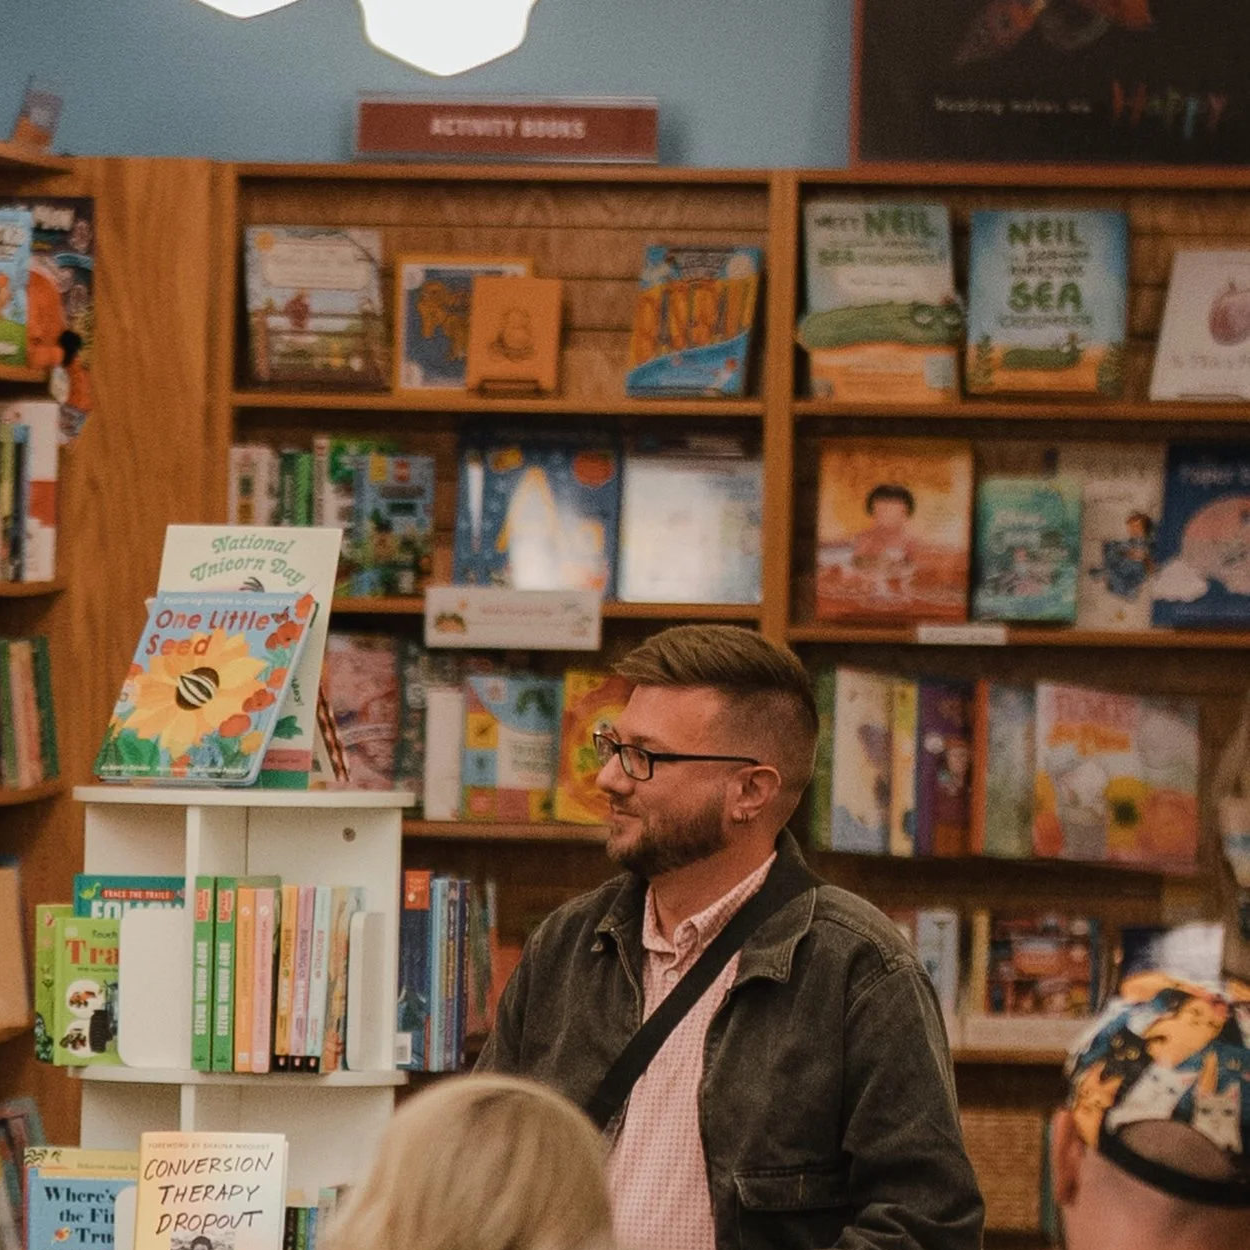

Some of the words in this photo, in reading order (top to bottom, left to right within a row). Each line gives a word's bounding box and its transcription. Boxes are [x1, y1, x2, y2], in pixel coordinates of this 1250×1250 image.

[431, 116, 515, 137] ACTIVITY
[520, 119, 586, 140] BOOKS
[1007, 218, 1084, 247] NEIL
[1007, 282, 1084, 313] SEA
[211, 533, 296, 555] National
[189, 555, 265, 582] Unicorn
[270, 555, 306, 588] Day
[155, 609, 202, 630] One
[208, 607, 271, 631] Little
[146, 634, 213, 657] Seed
[103, 889, 127, 898] TRACE
[129, 890, 143, 899] THE
[145, 891, 171, 900] TRAILS
[143, 1152, 274, 1181] CONVERSION
[44, 1186, 116, 1203] Where's
[158, 1183, 260, 1206] THERAPY
[59, 1208, 84, 1223] the
[155, 1209, 263, 1236] DROPOUT
